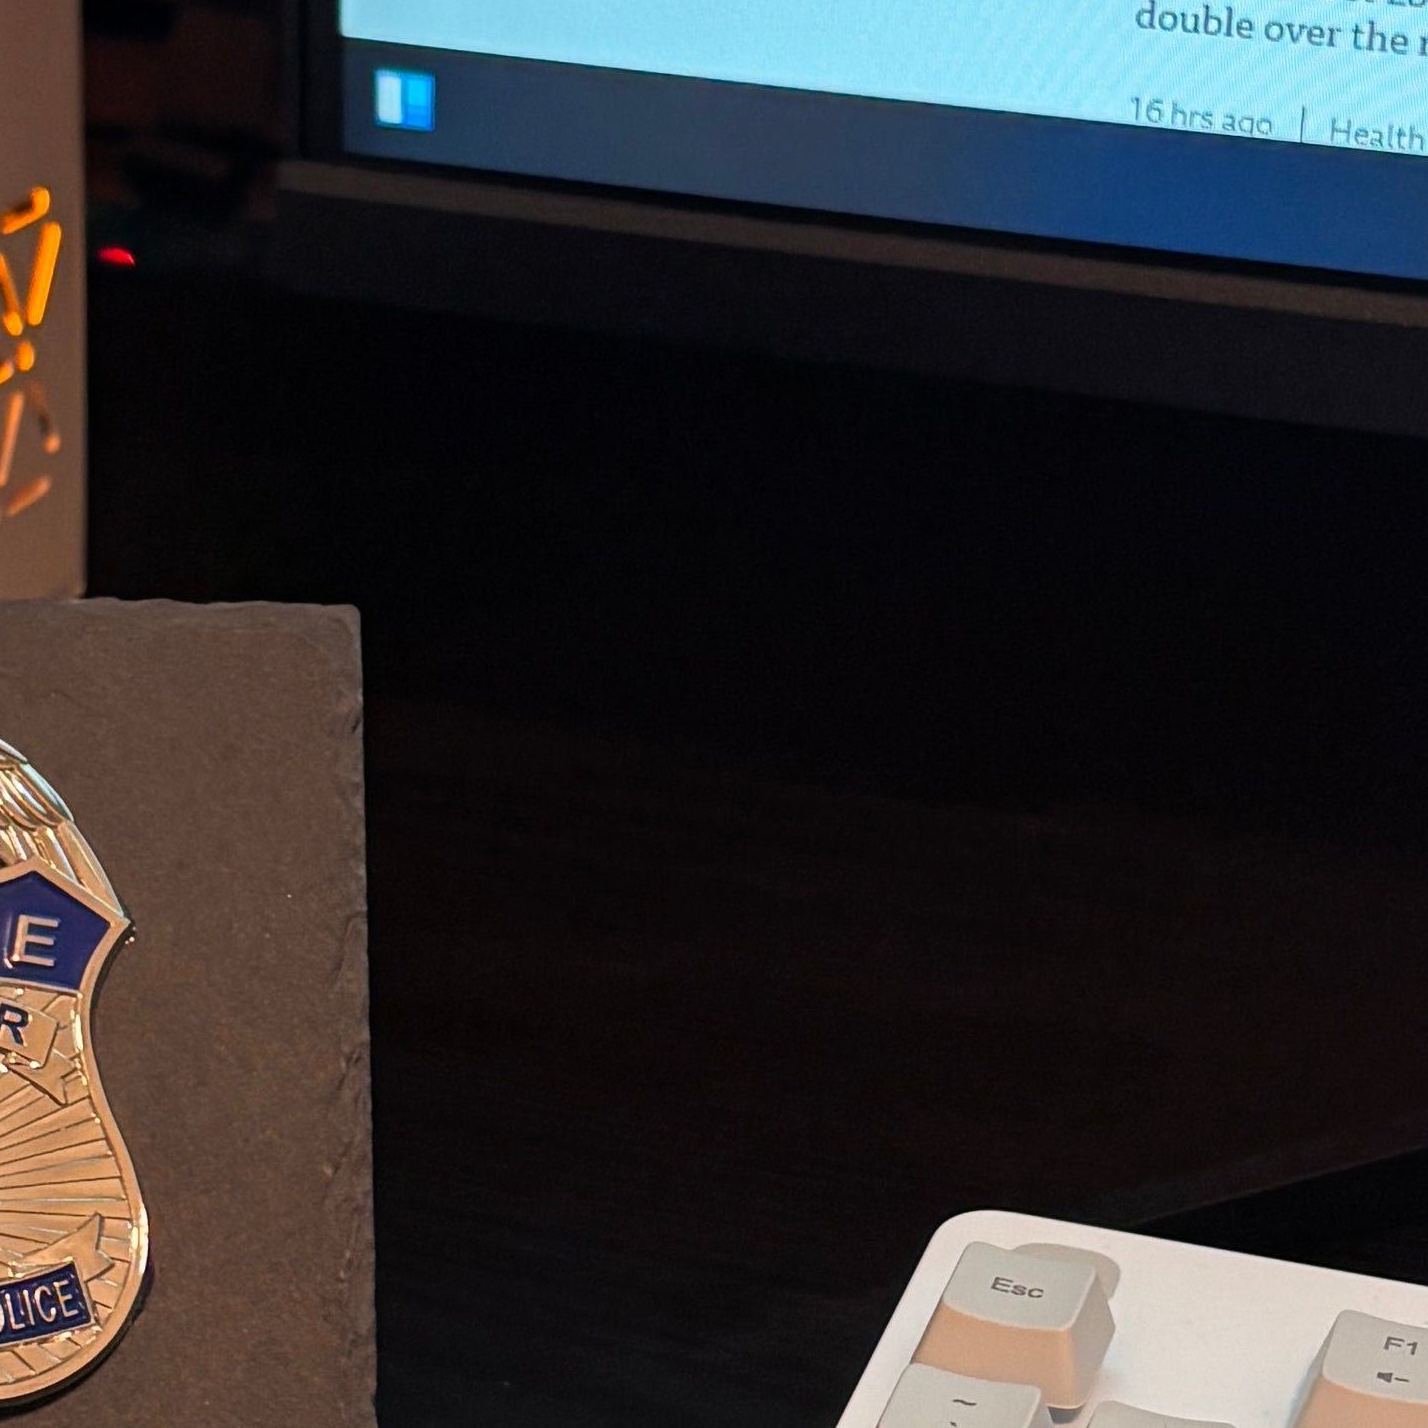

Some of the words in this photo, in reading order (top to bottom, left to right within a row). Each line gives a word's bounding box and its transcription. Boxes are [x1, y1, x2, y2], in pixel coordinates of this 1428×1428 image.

[1135, 0, 1255, 41] double
[1263, 18, 1342, 47] over
[1352, 19, 1410, 54] the
[1131, 96, 1164, 122] 16
[1172, 101, 1213, 129] hrs
[1331, 117, 1425, 150] Health
[990, 1276, 1045, 1299] Esc
[1383, 1335, 1418, 1356] F1
